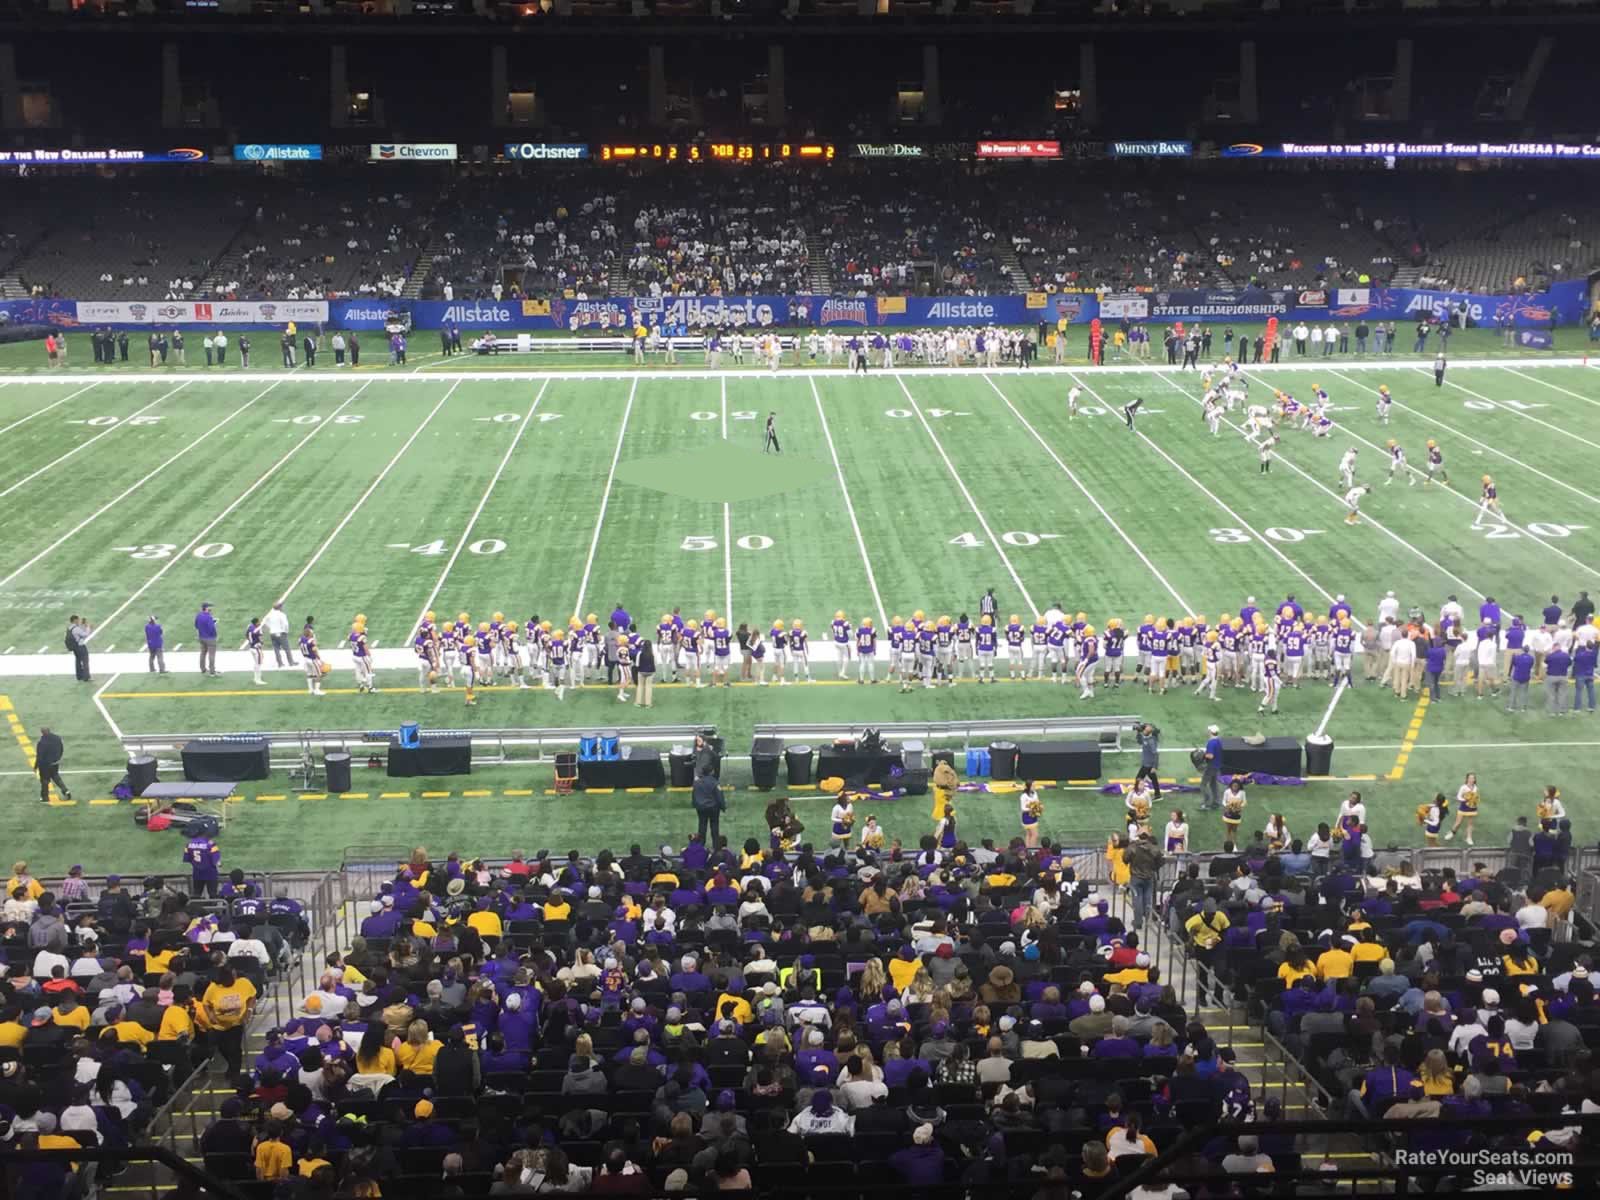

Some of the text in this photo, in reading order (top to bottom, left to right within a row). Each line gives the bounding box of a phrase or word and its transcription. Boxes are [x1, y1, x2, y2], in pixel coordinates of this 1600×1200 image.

[265, 146, 310, 158] Allstate
[400, 146, 448, 156] Chevron
[521, 144, 581, 158] Ochsner
[1159, 142, 1185, 153] BANK
[1365, 143, 1395, 153] 2016
[573, 302, 619, 314] Allstate
[822, 299, 865, 310] Allstate
[927, 301, 994, 319] Allstate
[1153, 305, 1189, 315] STATE
[1193, 304, 1287, 315] CHAMPIONSHIPS
[442, 306, 510, 323] Allstate
